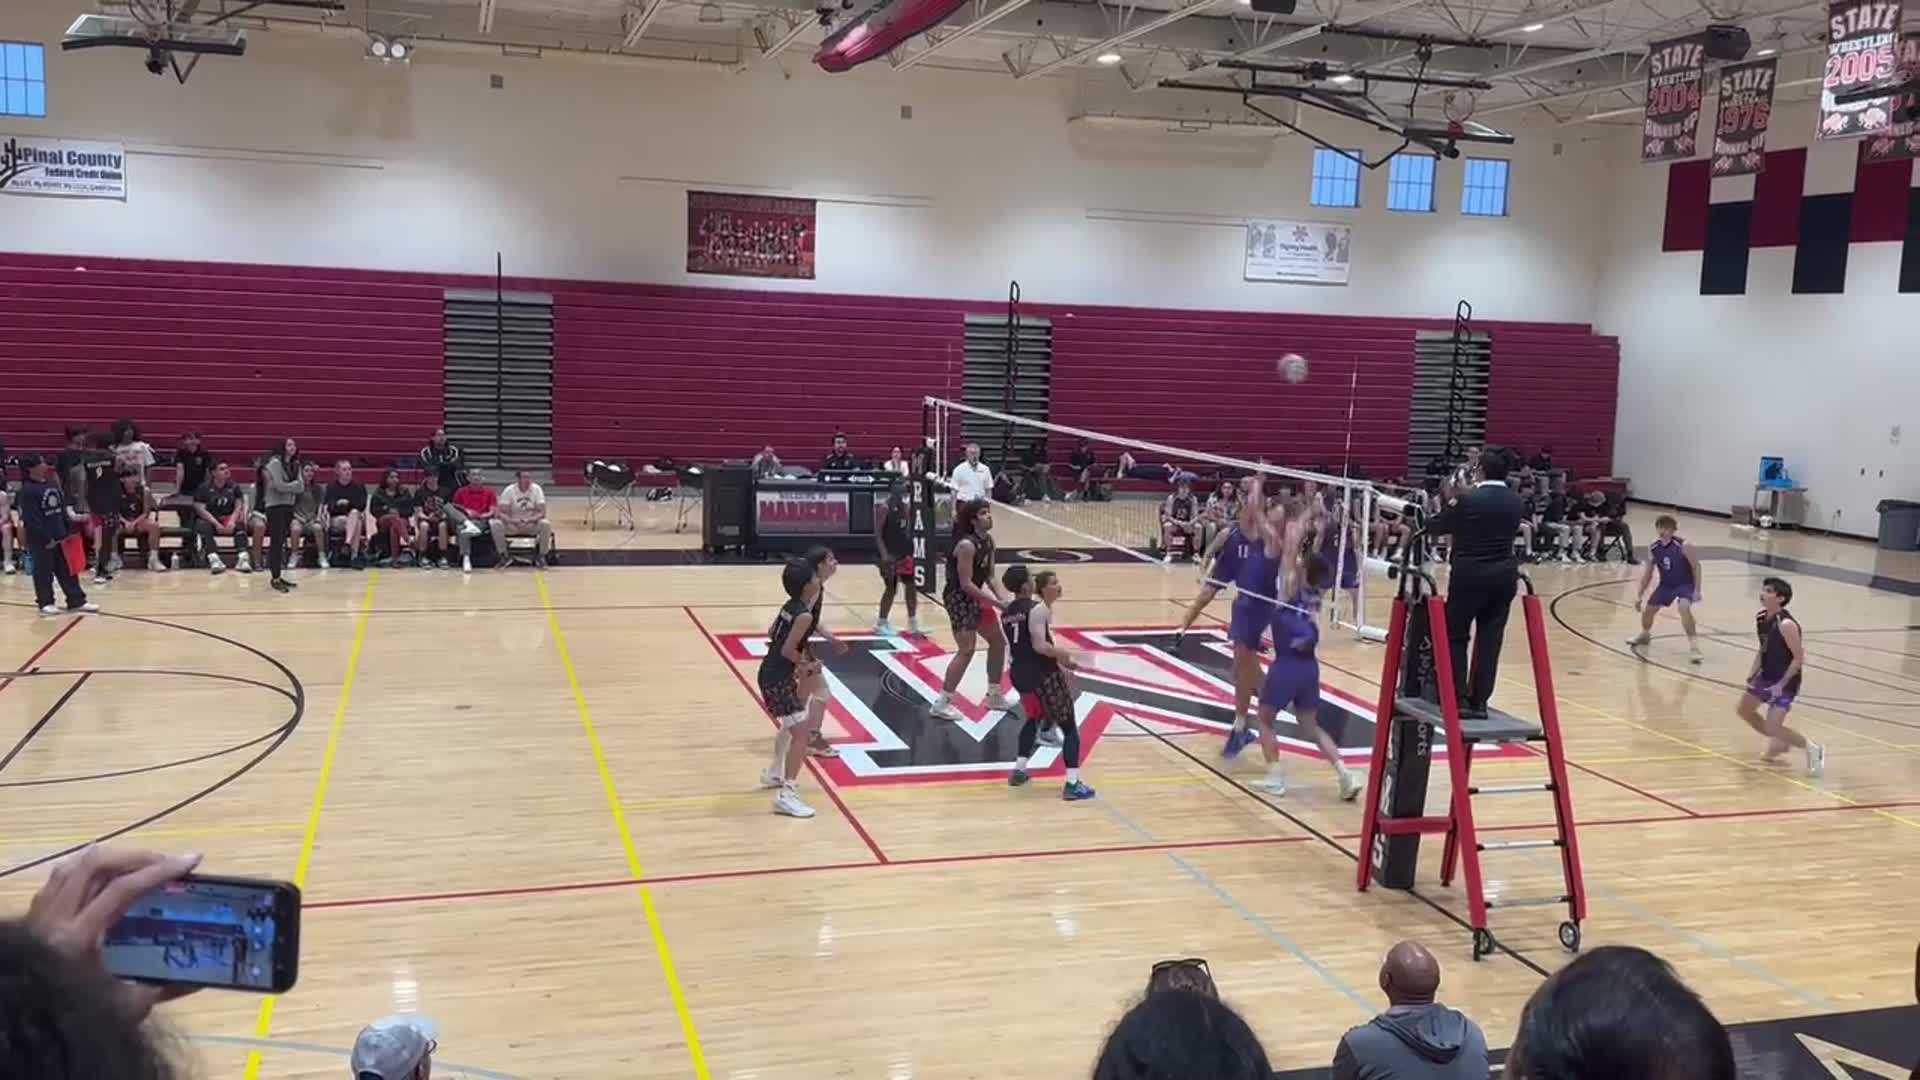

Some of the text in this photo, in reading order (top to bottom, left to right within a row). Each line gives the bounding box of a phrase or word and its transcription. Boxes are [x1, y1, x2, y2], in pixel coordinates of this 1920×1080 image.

[1831, 3, 1899, 40] STATE
[1650, 43, 1704, 75] STATE
[1823, 46, 1895, 88] 2005
[1721, 68, 1774, 97] STATE
[1647, 83, 1701, 116] 2004
[1717, 102, 1770, 135] 1976
[23, 147, 122, 169] Pinal County
[45, 166, 74, 178] Federal
[912, 480, 926, 587] RAMS
[1011, 623, 1019, 644] 7
